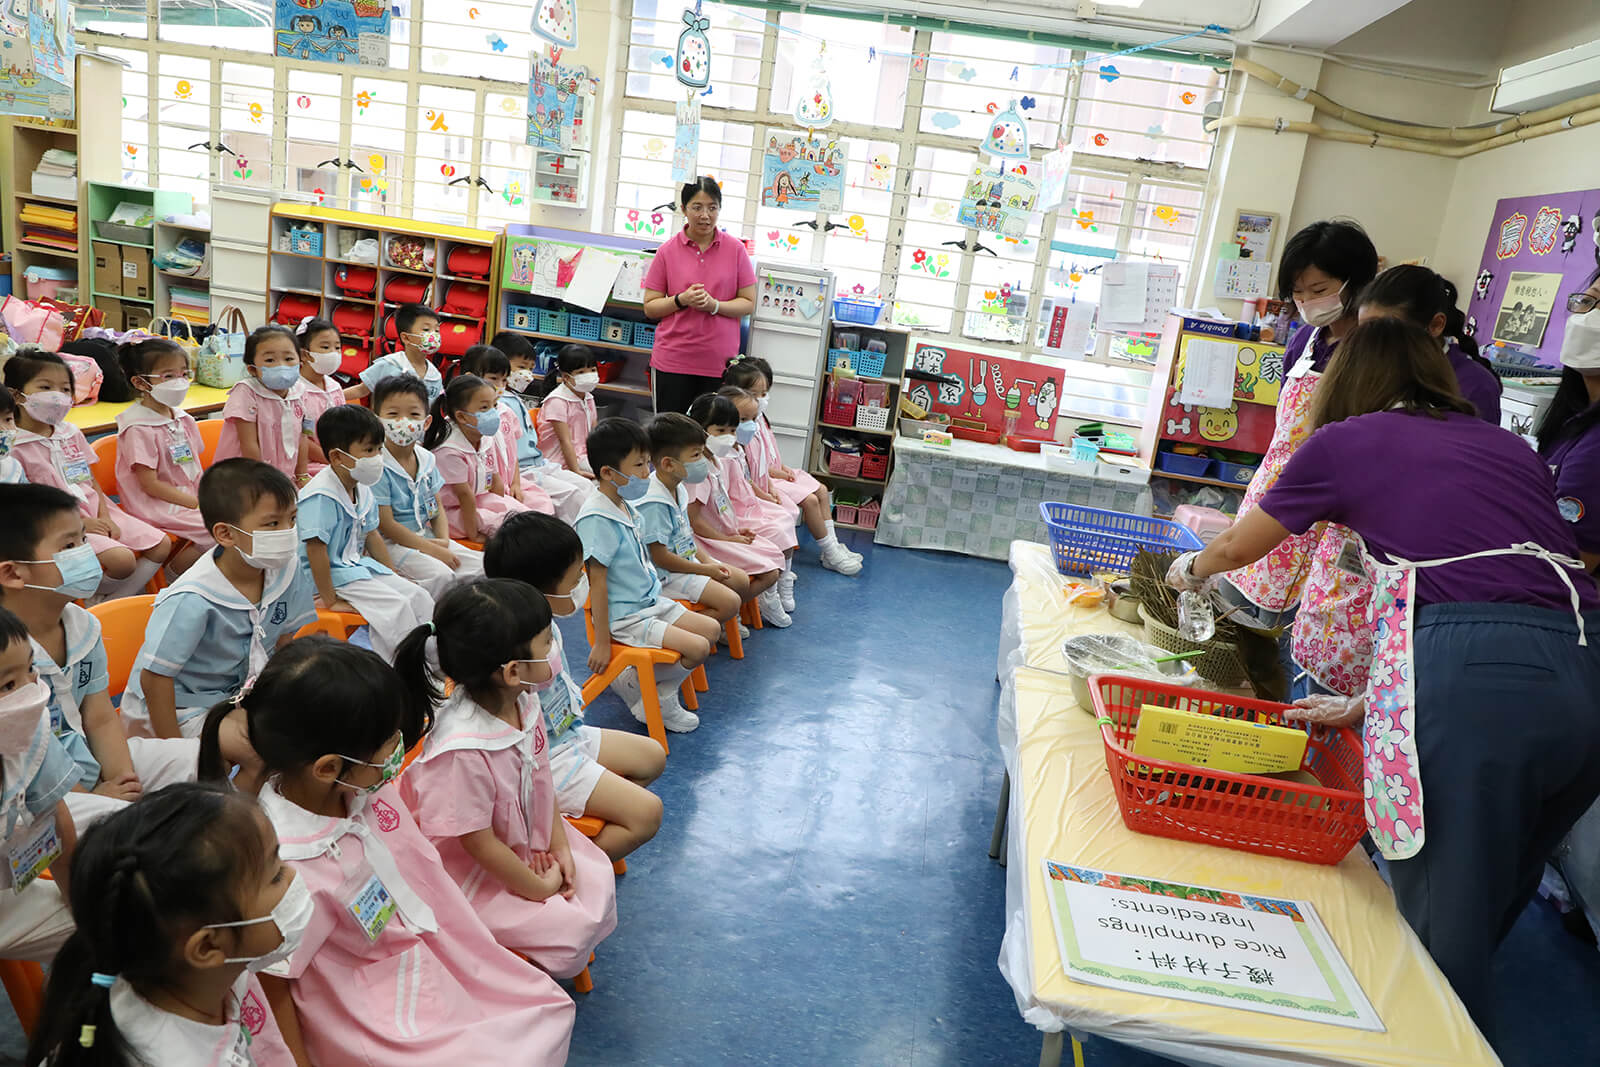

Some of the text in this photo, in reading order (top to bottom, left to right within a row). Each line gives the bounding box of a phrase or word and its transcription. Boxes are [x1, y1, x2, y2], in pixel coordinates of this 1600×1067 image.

[612, 329, 619, 338] 5
[1199, 322, 1229, 334] Double
[1262, 353, 1284, 381] 家
[1111, 897, 1255, 931] Ingredients:
[1098, 917, 1287, 960] Rice dumplings
